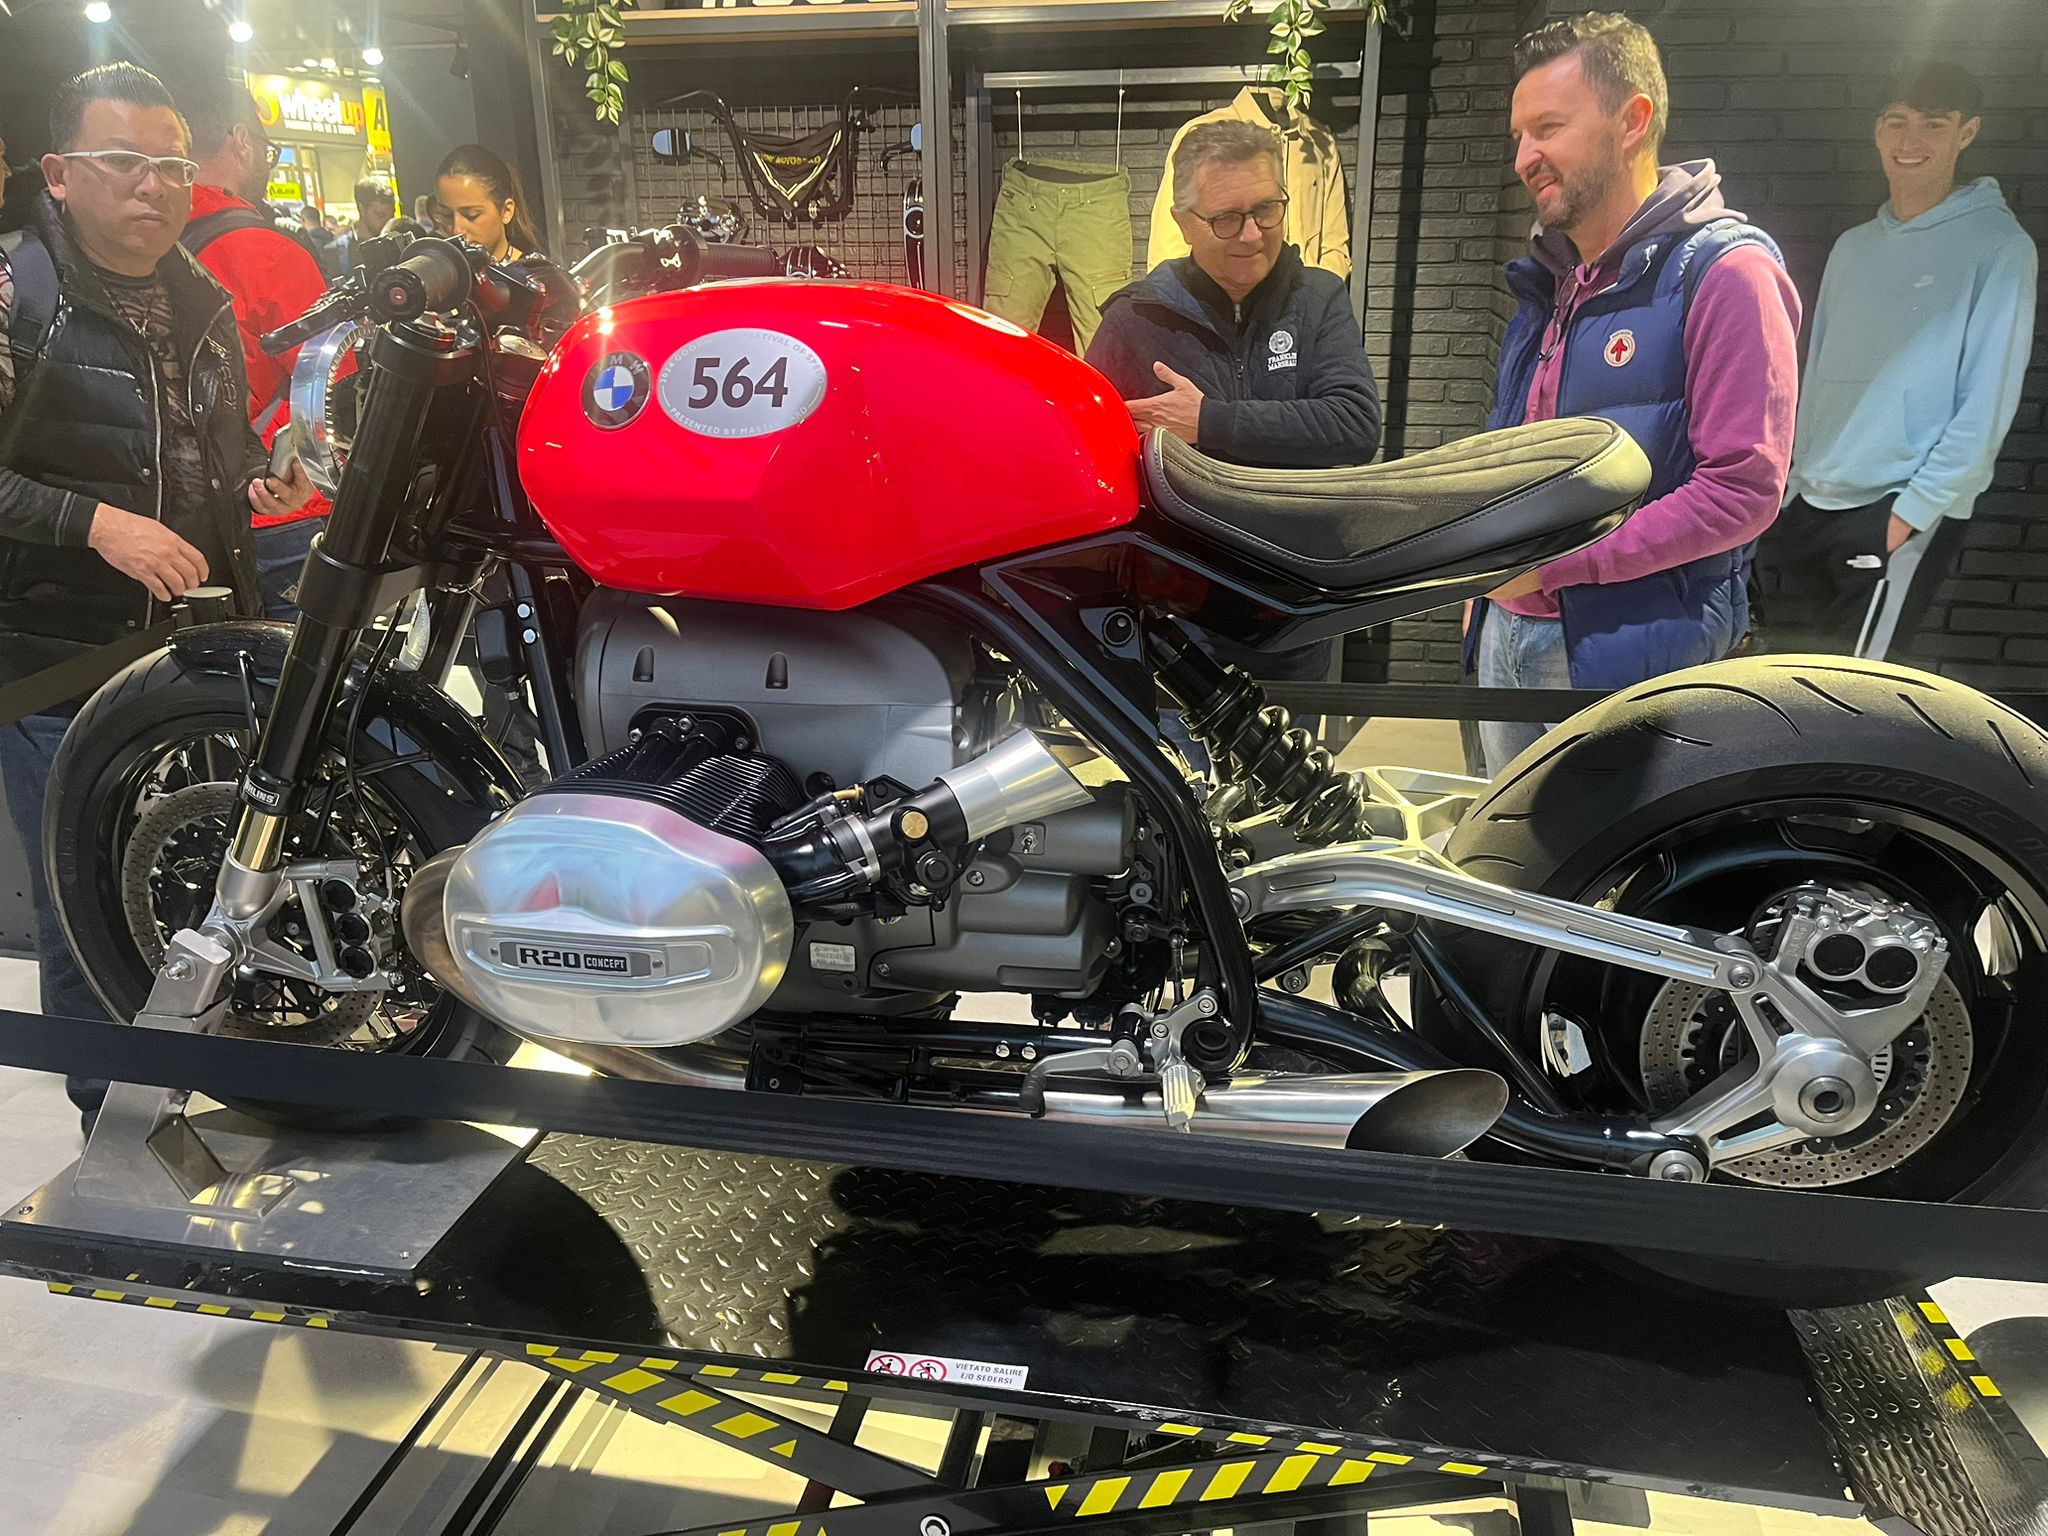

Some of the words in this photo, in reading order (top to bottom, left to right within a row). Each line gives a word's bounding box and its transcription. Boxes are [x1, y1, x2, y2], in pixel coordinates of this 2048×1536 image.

[659, 361, 675, 385] 2024
[792, 344, 807, 354] OF
[688, 356, 788, 409] 564
[669, 406, 720, 435] PRESENTED
[722, 427, 737, 436] BY
[1780, 768, 2015, 829] SPORTEC
[519, 947, 581, 969] R20
[586, 957, 625, 969] CONCEPT
[955, 1362, 991, 1373] VIETATO
[993, 1367, 1024, 1377] SALIRE
[976, 1374, 1013, 1384] SEDERSI
